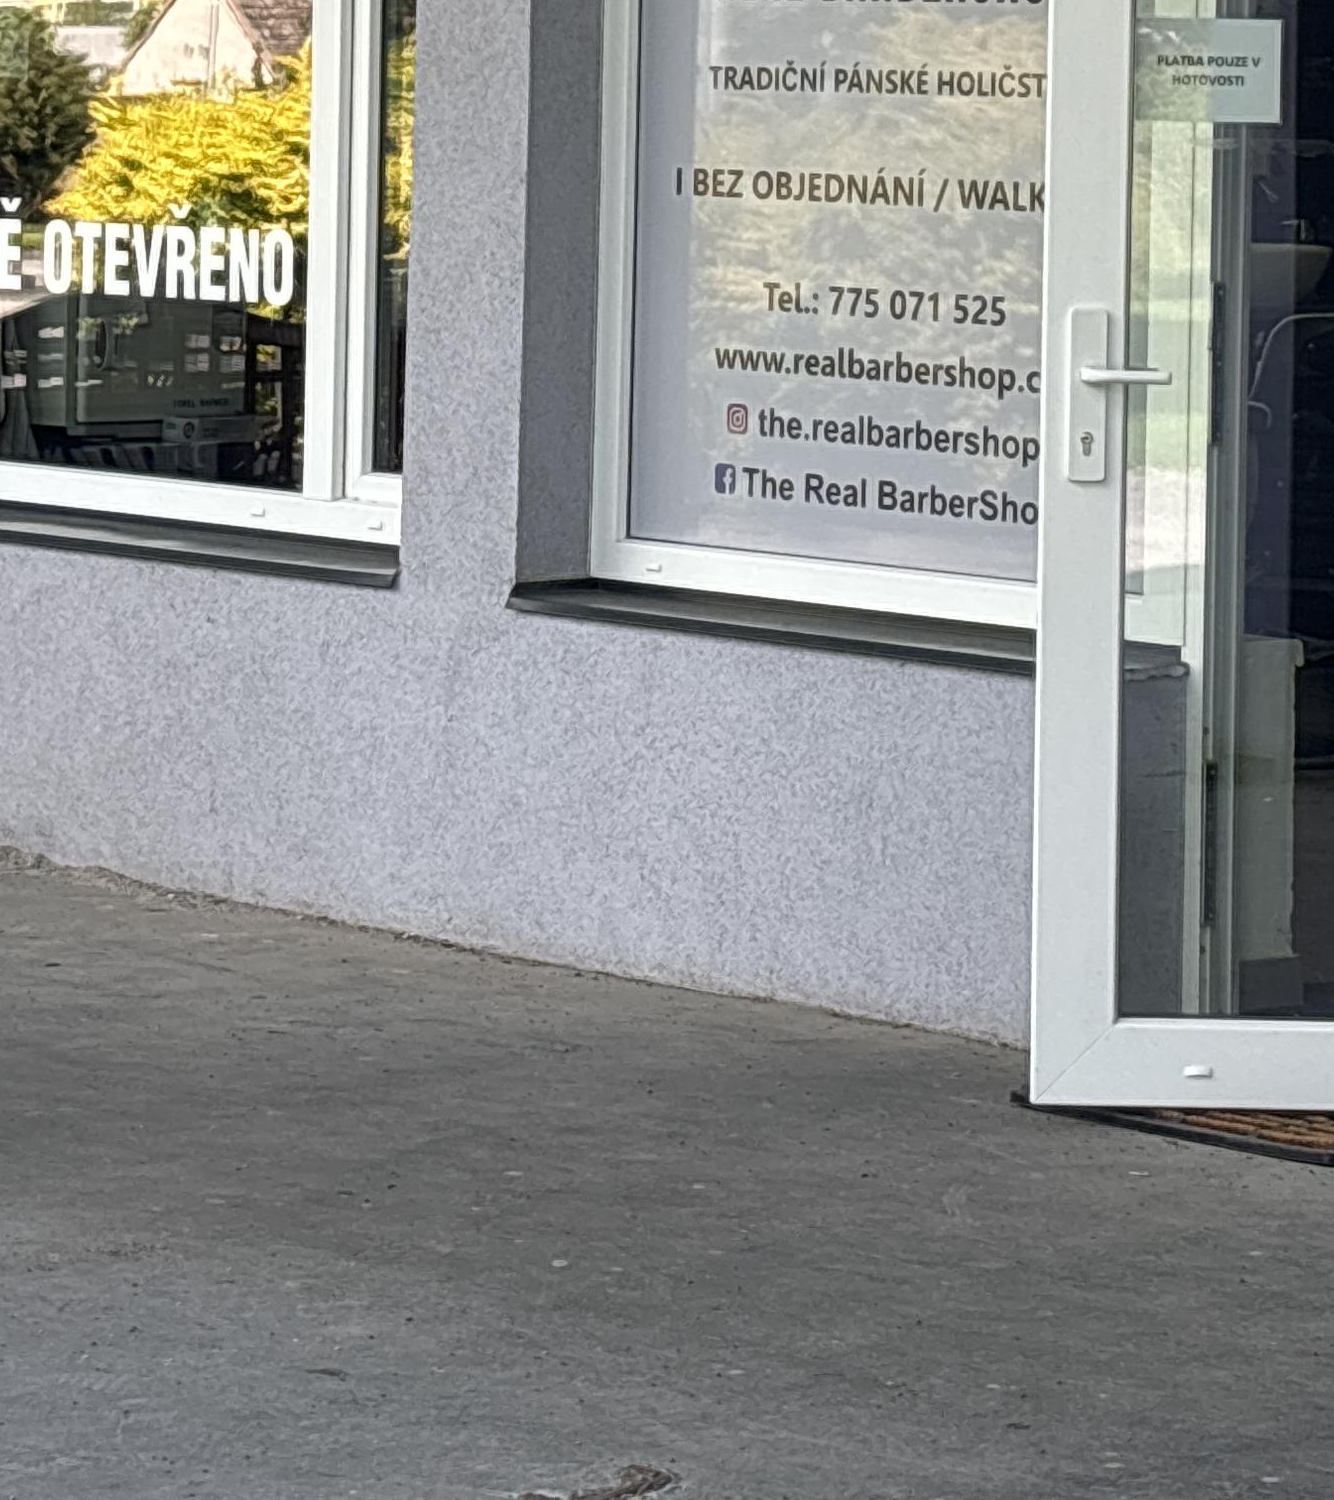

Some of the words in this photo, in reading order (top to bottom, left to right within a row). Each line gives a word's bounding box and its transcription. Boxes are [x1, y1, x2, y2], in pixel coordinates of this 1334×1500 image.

[709, 60, 827, 93] TRADIČNÍ
[833, 61, 929, 96] PÁNSKÉ
[937, 65, 1047, 98] HOLIČST
[1157, 55, 1203, 66] PLATBA
[1208, 56, 1248, 67] POUZE
[1252, 57, 1260, 67] V
[1173, 75, 1244, 86] HOTOVOSTI
[676, 167, 682, 196] I
[693, 168, 743, 198] BEZ
[752, 167, 925, 208] OBJEDNÁNÍ
[933, 177, 949, 213] /
[958, 178, 1046, 213] WALK
[44, 203, 294, 306] OTEVŘENO
[763, 281, 819, 315] Tel.:
[828, 286, 880, 319] 775
[889, 290, 940, 322] 071
[953, 294, 1006, 327] 525
[715, 347, 1041, 400] www.realbarbershop.c
[758, 407, 1040, 467] the.realbarbershop
[742, 466, 795, 501] The
[804, 473, 866, 509] Real
[877, 480, 1039, 526] BarberSho
